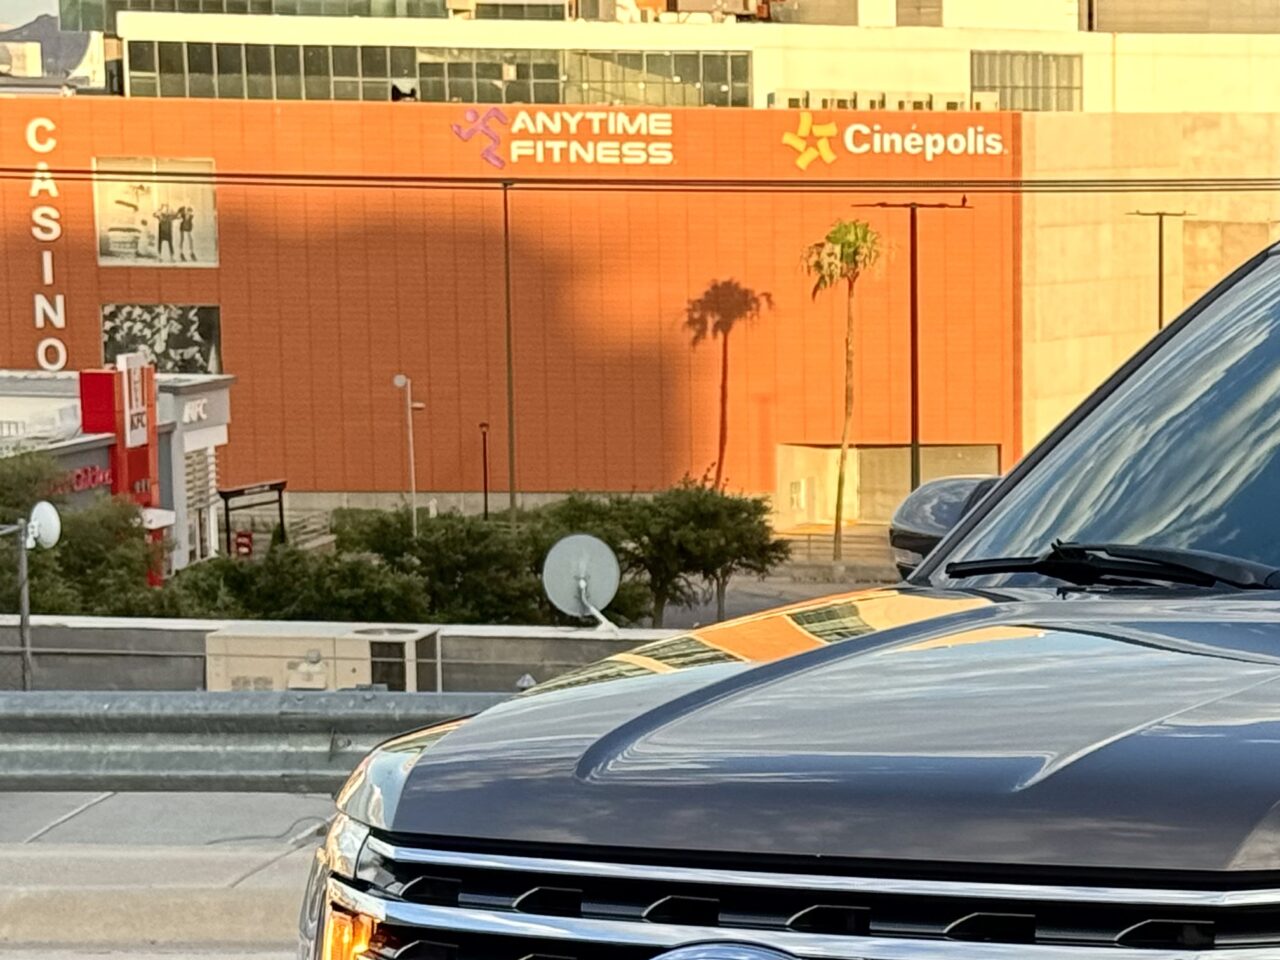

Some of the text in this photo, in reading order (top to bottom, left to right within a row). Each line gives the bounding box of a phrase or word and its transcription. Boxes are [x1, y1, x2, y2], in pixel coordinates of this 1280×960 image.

[511, 111, 673, 135] ANYTIME
[511, 140, 673, 165] FITNESS
[843, 122, 1003, 161] Cinépolis
[25, 117, 68, 371] CASINO
